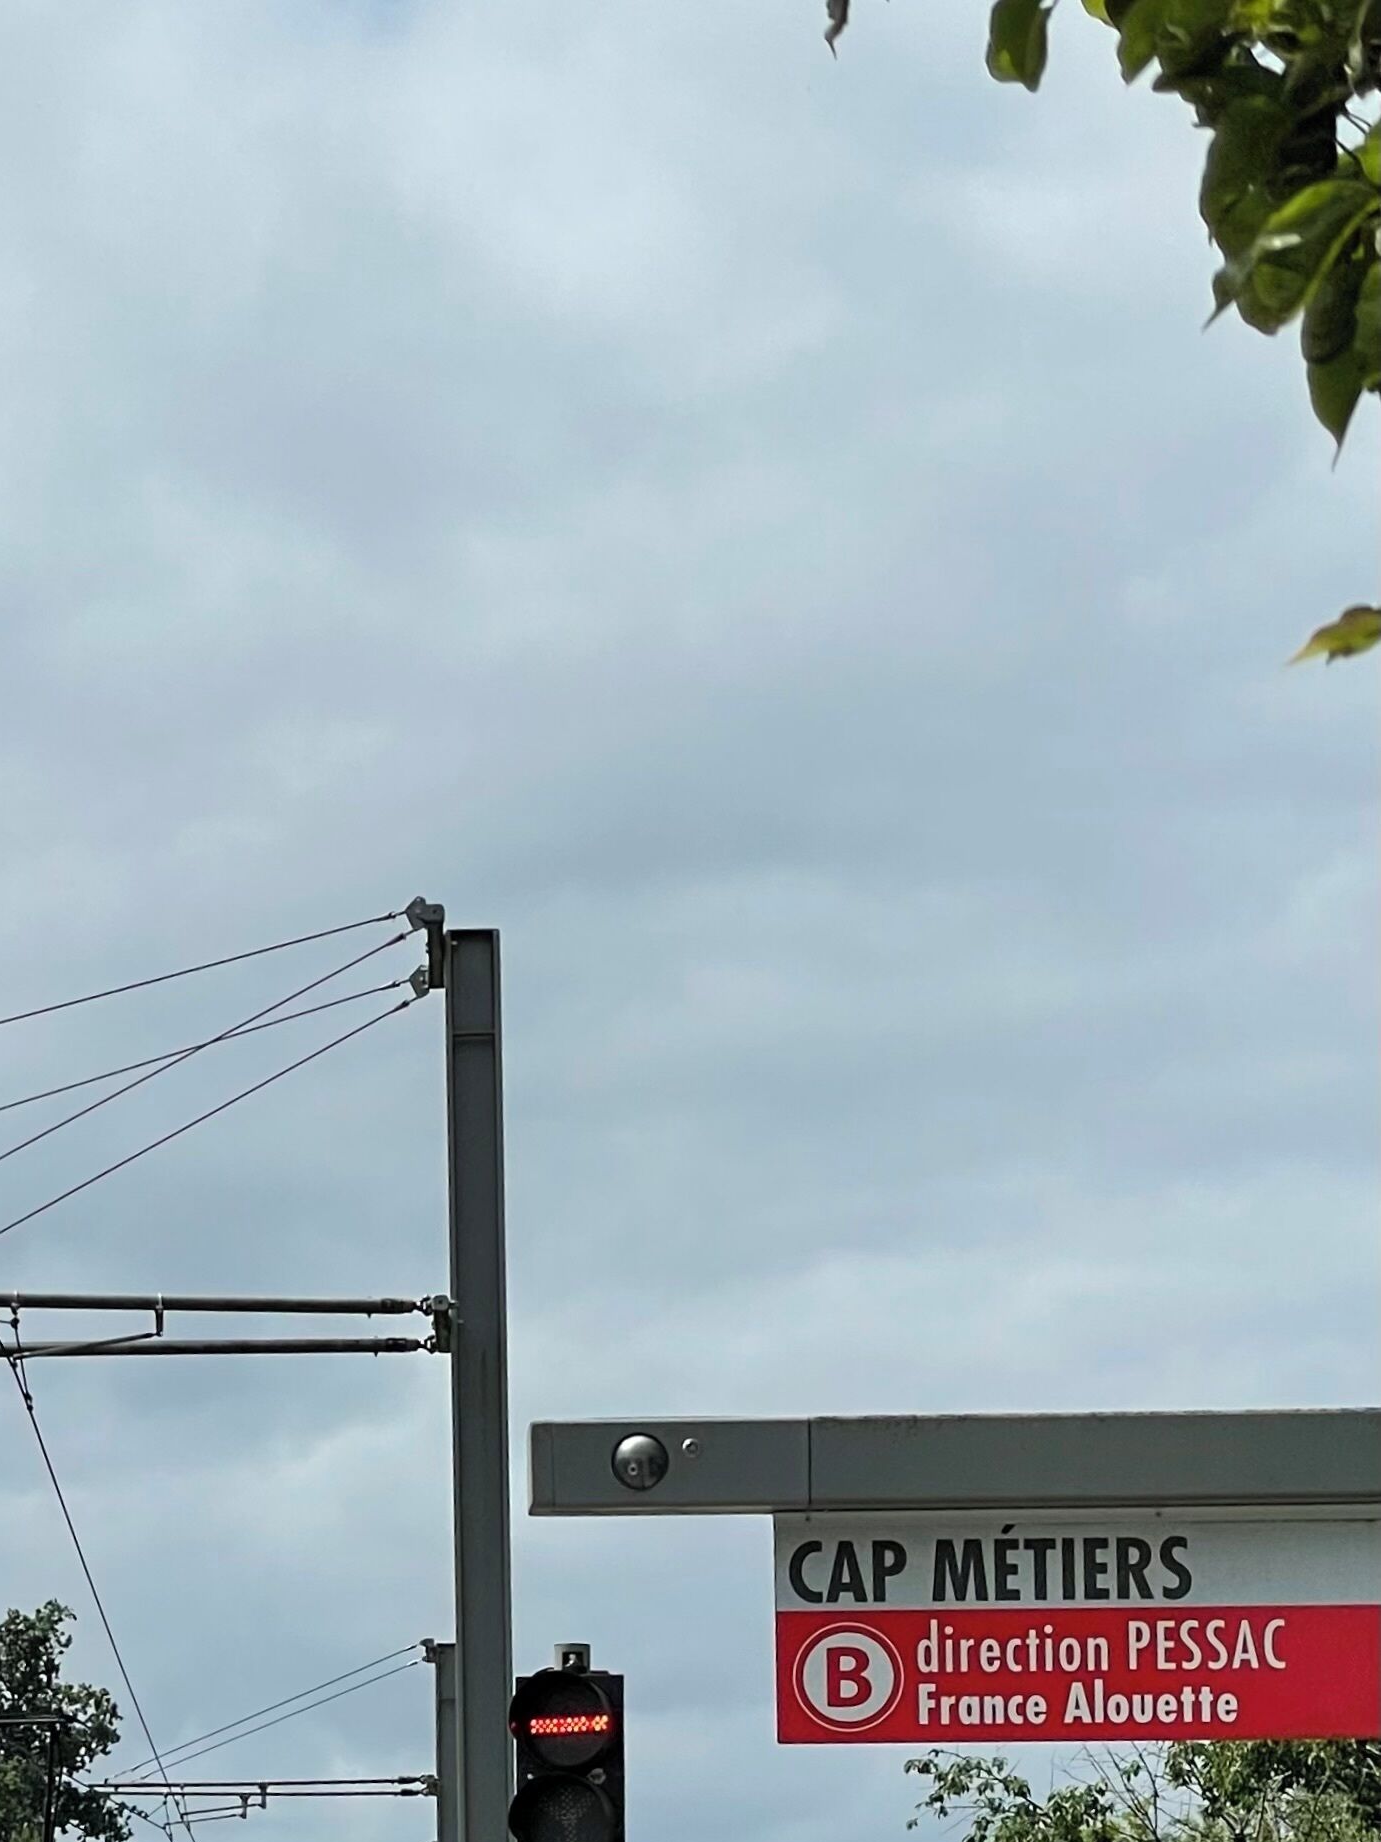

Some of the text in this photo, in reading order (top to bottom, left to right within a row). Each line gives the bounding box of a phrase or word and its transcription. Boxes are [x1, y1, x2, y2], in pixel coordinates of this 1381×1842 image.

[788, 1523, 1193, 1604] CAP MÉTIERS
[917, 1618, 1287, 1673] direction PESSAC
[825, 1646, 873, 1708] B
[917, 1678, 1239, 1726] France Alouette
